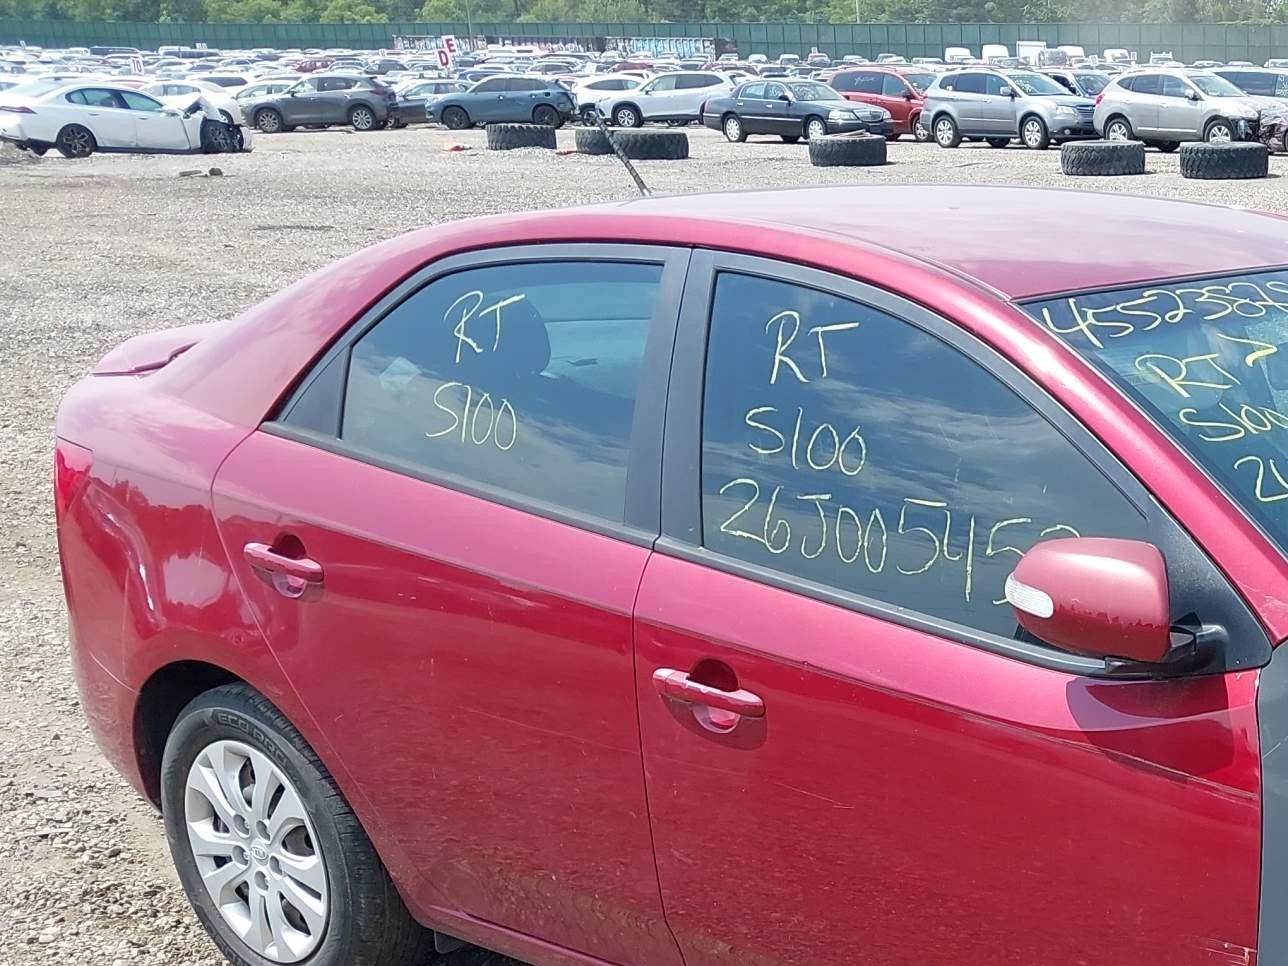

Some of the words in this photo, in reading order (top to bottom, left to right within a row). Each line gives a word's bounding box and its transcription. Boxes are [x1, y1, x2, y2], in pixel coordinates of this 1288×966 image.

[437, 50, 449, 67] D
[445, 38, 456, 53] E
[444, 290, 526, 363] RT
[765, 310, 861, 385] RT
[1134, 353, 1241, 398] RT
[425, 382, 517, 450] S100
[744, 406, 868, 477] S100
[718, 477, 1082, 606] 26J00545
